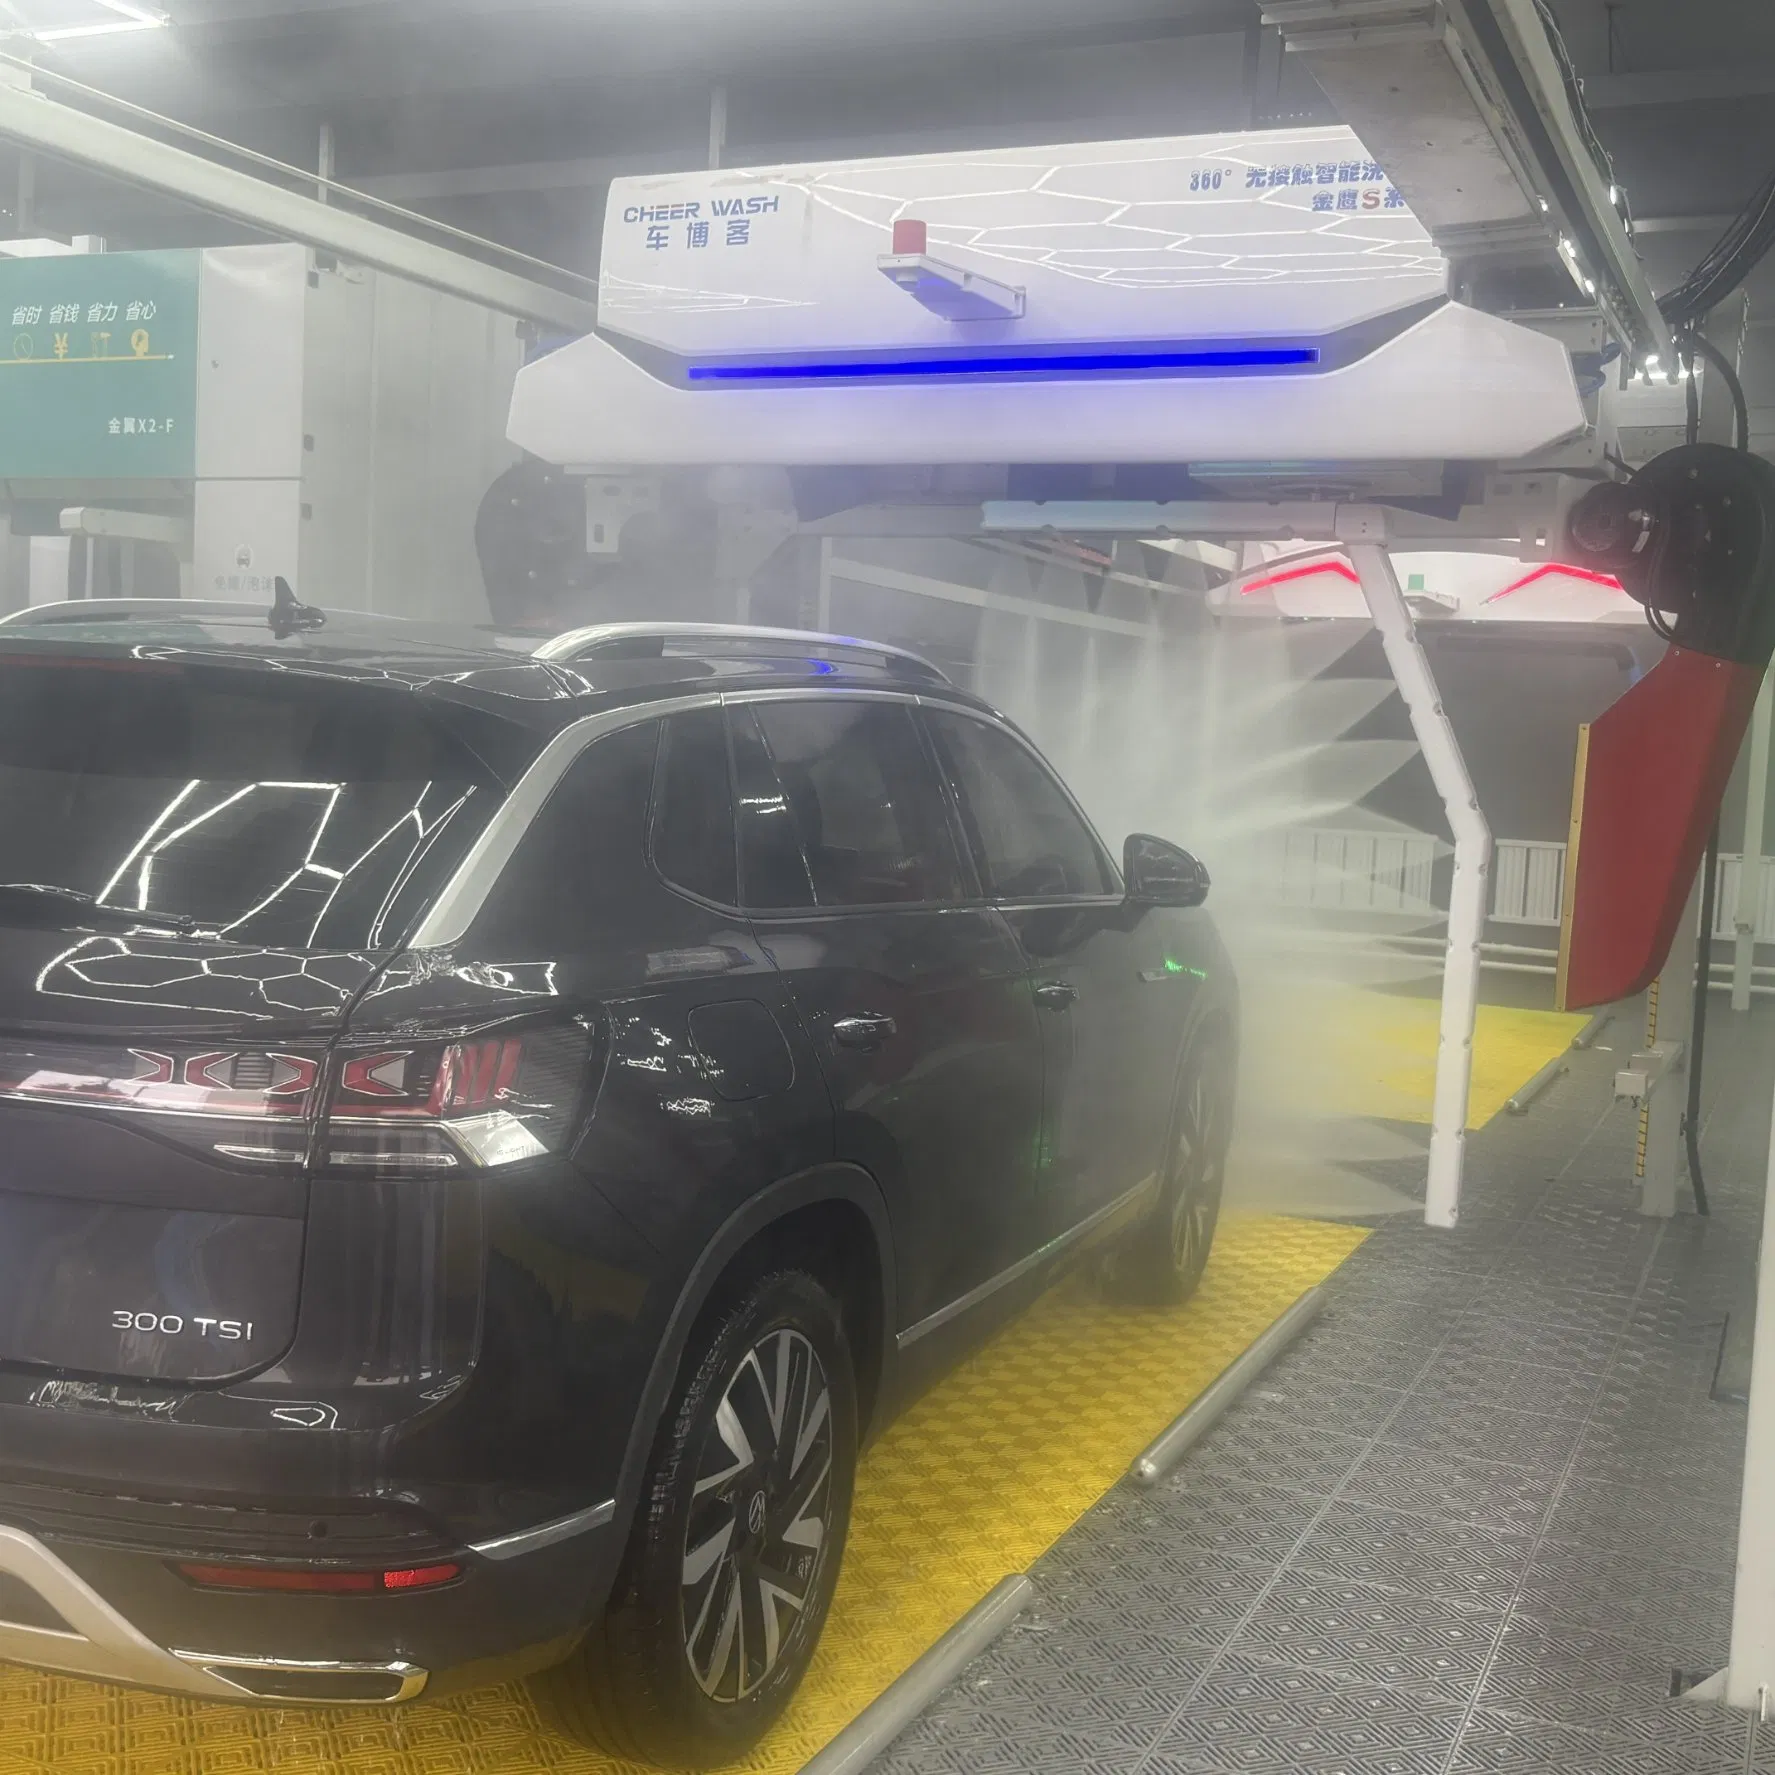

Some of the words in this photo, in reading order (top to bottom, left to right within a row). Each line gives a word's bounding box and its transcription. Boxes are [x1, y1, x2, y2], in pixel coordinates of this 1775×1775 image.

[623, 202, 701, 223] CHEER
[711, 195, 779, 217] WASH
[646, 219, 751, 250] 车博客
[12, 304, 42, 326] 省时
[49, 302, 80, 324] 省钱
[87, 301, 118, 323] 省力
[125, 300, 157, 321] 省心
[112, 1310, 184, 1334] 300
[193, 1317, 253, 1341] TSI
